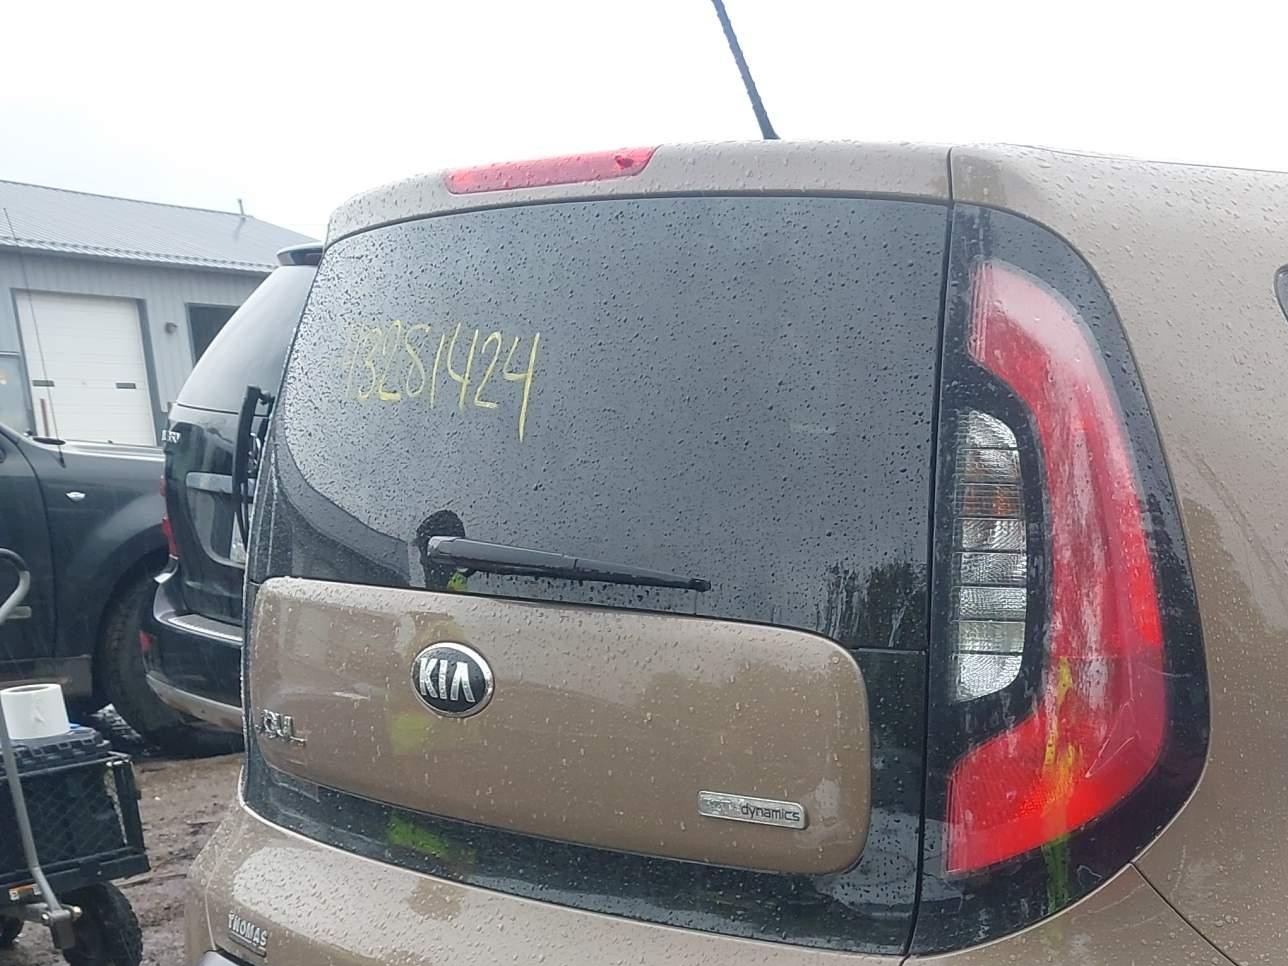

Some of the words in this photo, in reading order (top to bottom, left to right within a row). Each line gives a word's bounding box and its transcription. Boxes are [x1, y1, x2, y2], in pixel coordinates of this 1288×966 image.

[419, 657, 476, 703] KIA
[740, 802, 801, 823] dynamics
[228, 911, 268, 947] THOMAS
